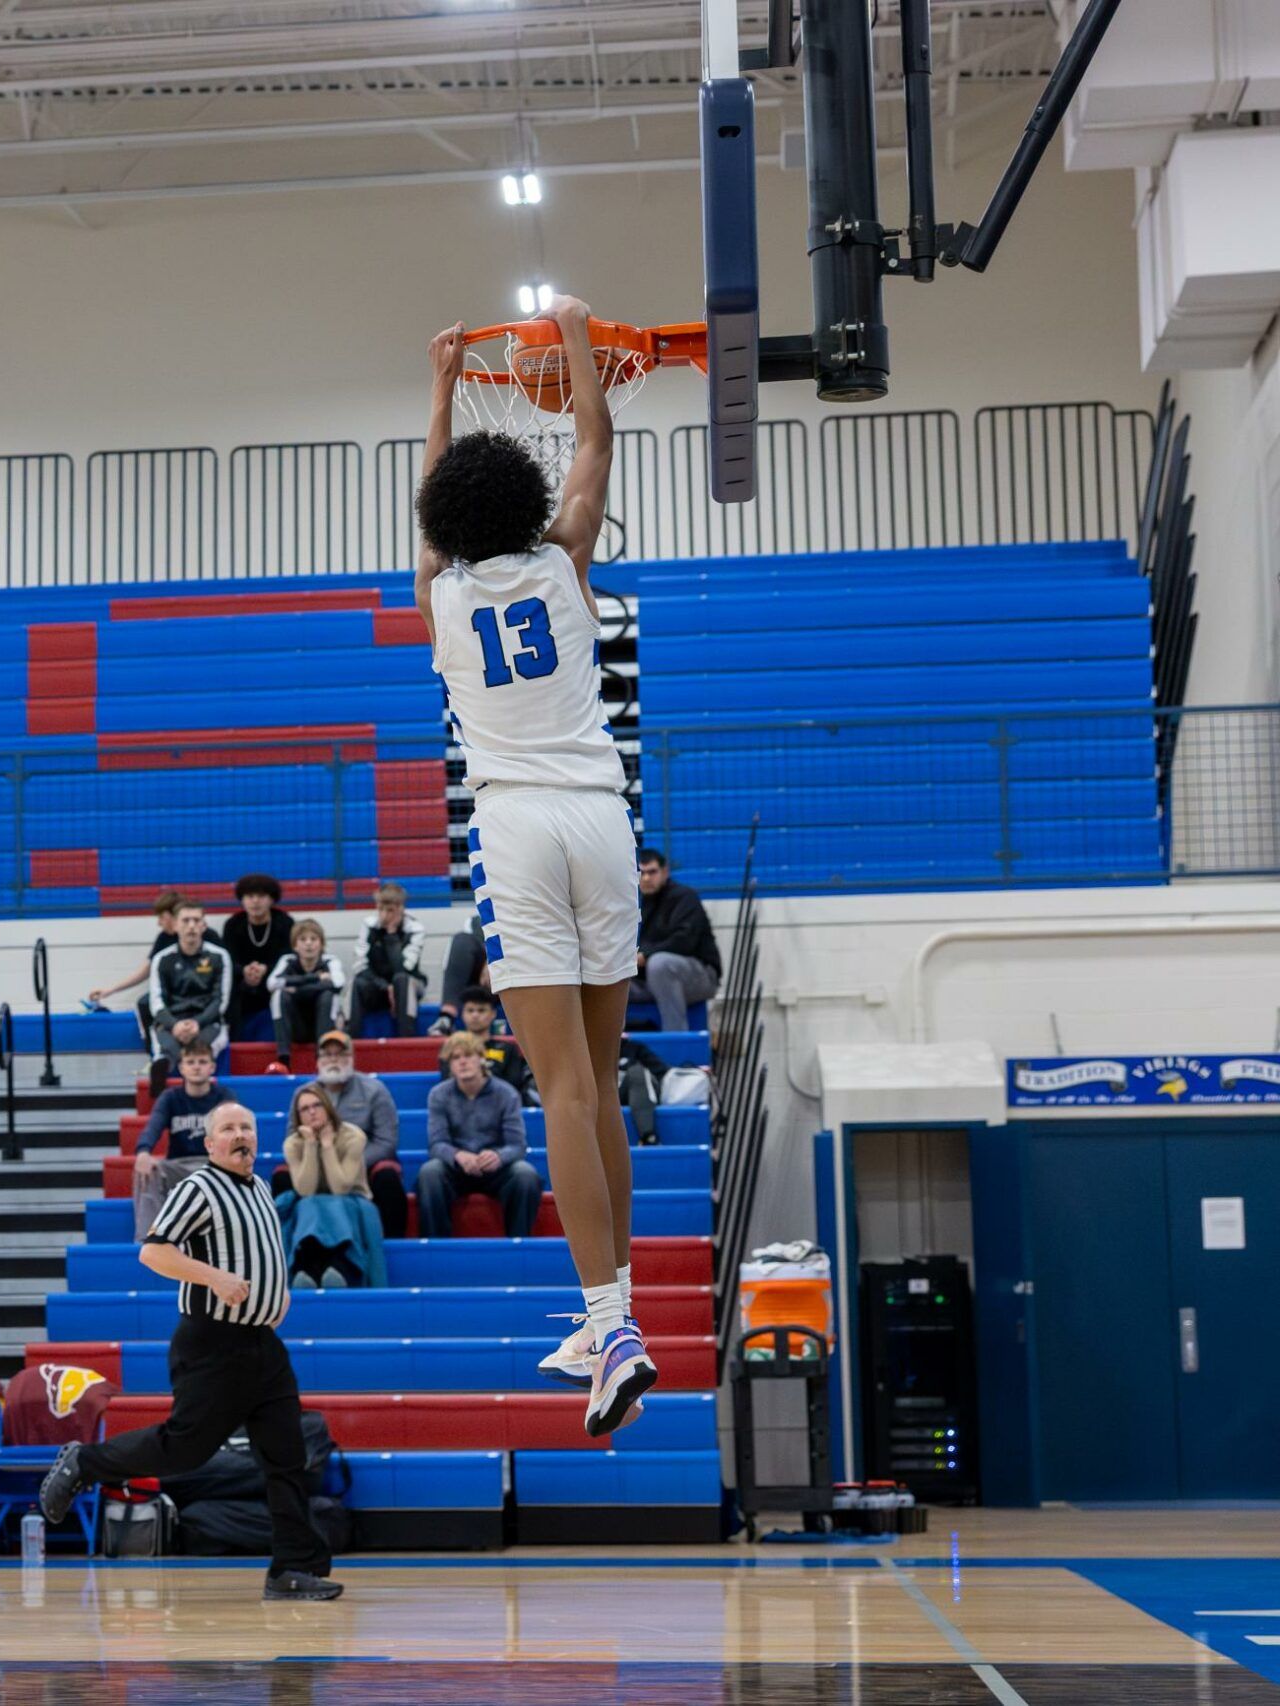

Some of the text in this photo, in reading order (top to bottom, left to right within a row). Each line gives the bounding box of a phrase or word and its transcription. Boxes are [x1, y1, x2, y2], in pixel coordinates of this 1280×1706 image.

[471, 596, 559, 688] 13
[1022, 1064, 1117, 1086] TRADITION
[1131, 1056, 1212, 1079] VIKINGS
